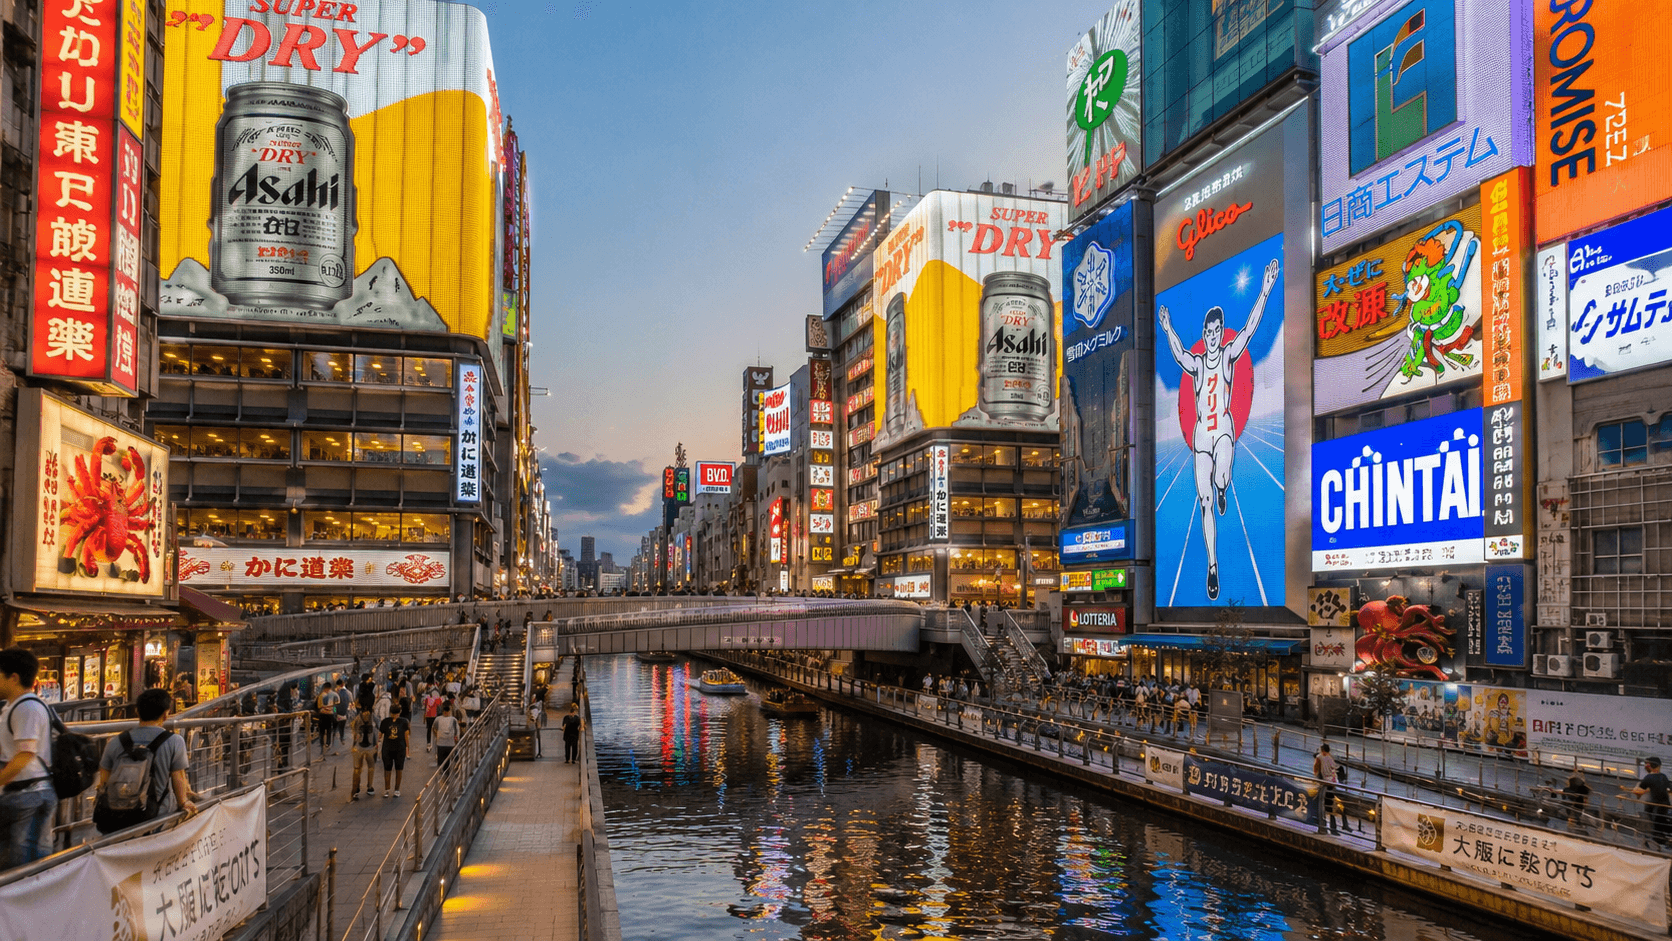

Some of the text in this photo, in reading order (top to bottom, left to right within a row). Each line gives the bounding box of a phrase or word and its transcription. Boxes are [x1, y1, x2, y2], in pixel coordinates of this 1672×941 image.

[228, 163, 339, 211] Asahi
[1321, 127, 1499, 238] 日商エステム
[990, 206, 1049, 225] SUPER
[1176, 202, 1254, 261] Glico
[986, 325, 1047, 357] Asahi
[1079, 612, 1118, 627] LOTTERIA
